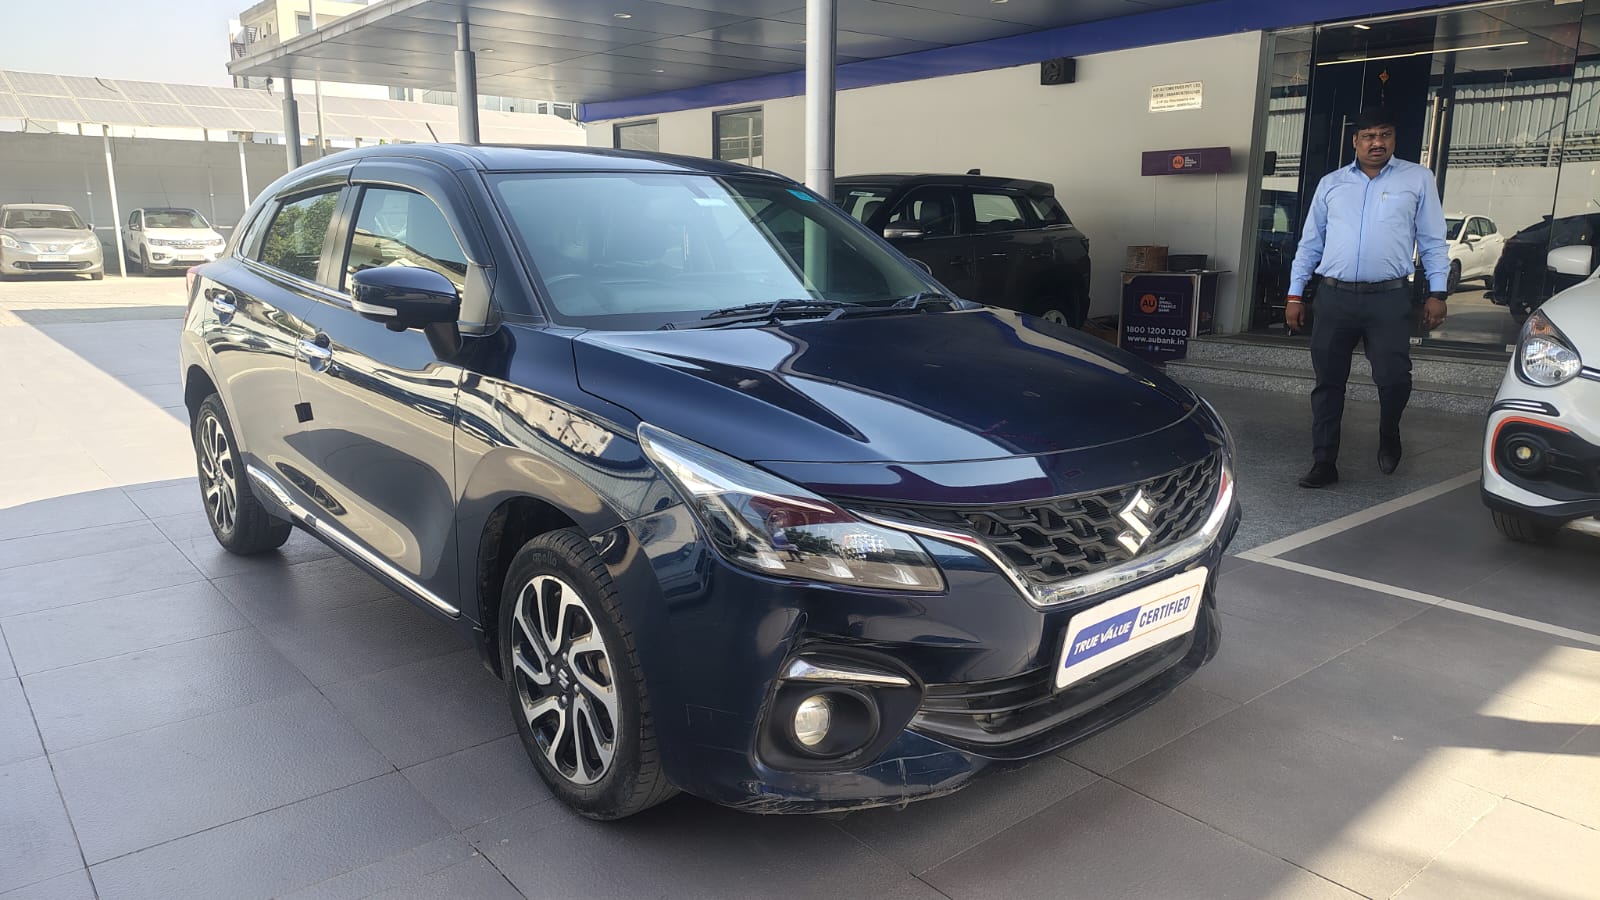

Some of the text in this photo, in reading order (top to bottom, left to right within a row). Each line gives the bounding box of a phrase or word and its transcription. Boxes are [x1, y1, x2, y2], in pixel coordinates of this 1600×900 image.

[1126, 325, 1187, 336] 1800 1200 1200
[1127, 335, 1185, 345] www.aubank.in
[1074, 596, 1191, 655] TRUE VALUE CERTIFIED
